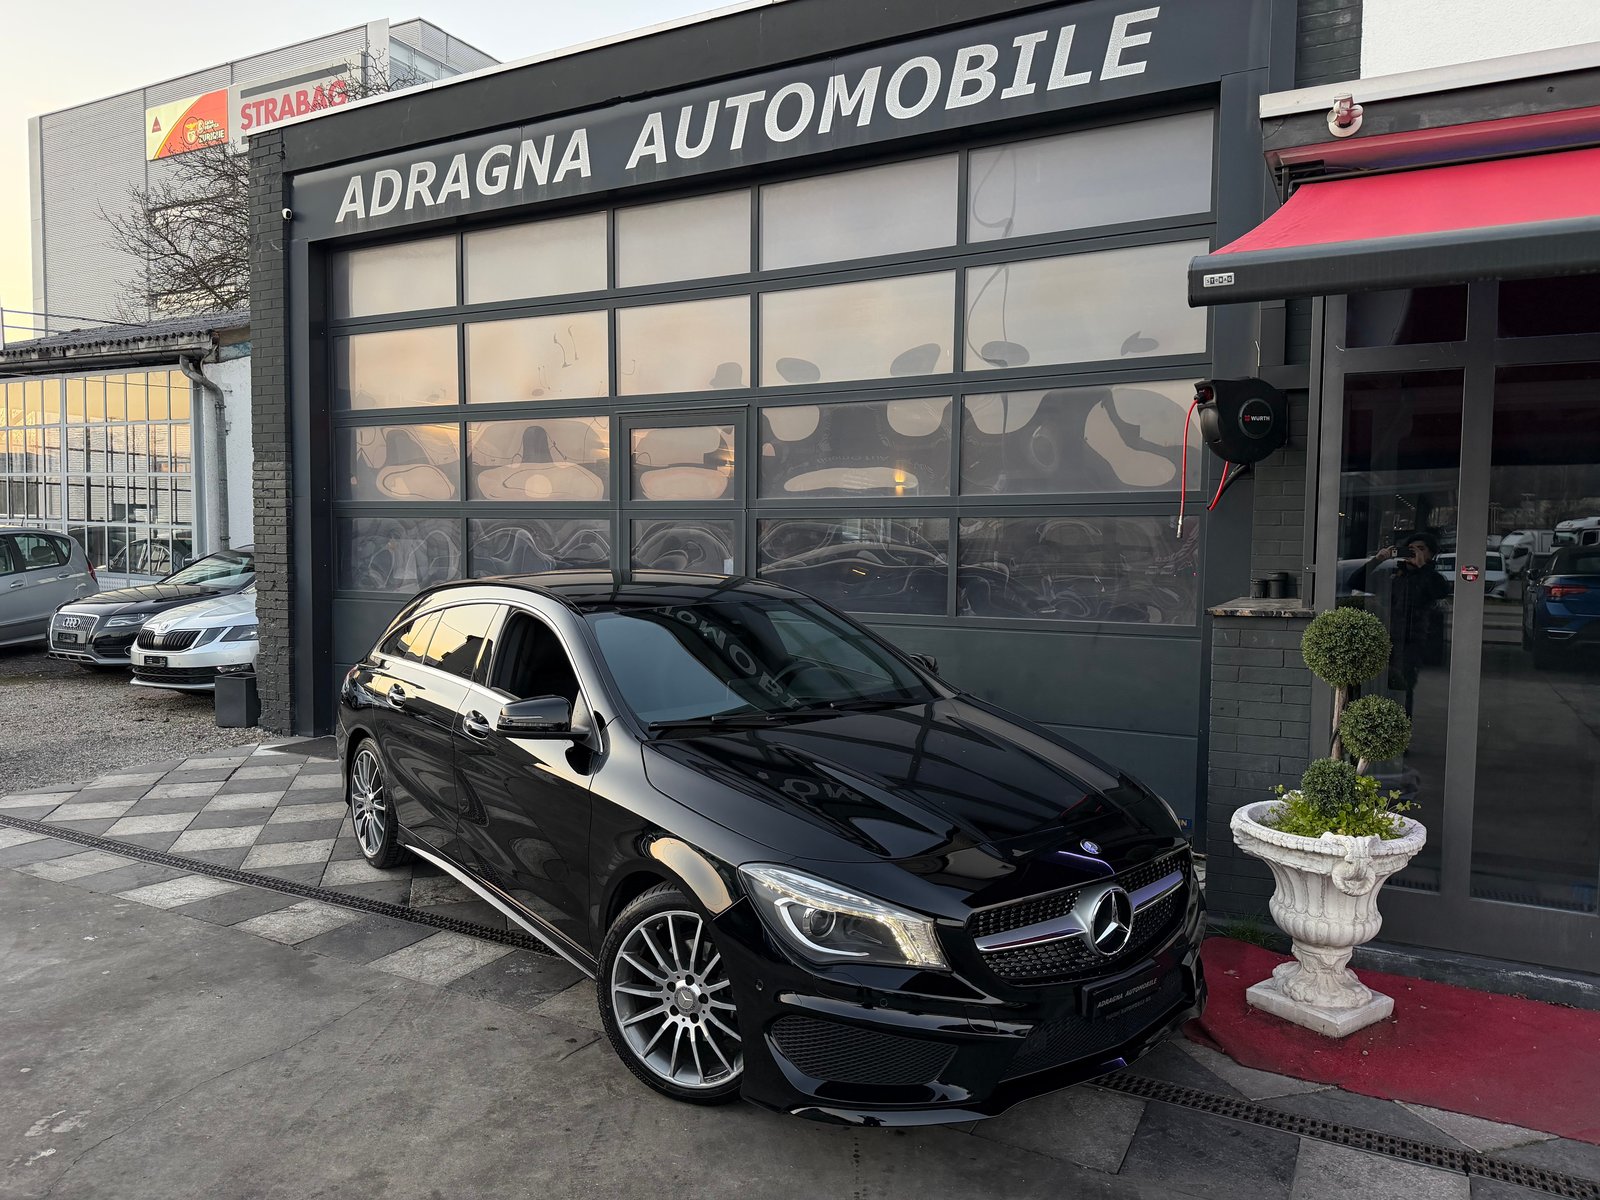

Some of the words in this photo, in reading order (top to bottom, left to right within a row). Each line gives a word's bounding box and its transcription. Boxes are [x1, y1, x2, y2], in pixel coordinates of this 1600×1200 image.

[240, 80, 347, 130] STRABAG
[335, 128, 592, 224] ADRAGNA
[625, 6, 1161, 170] AUTOMOBILE
